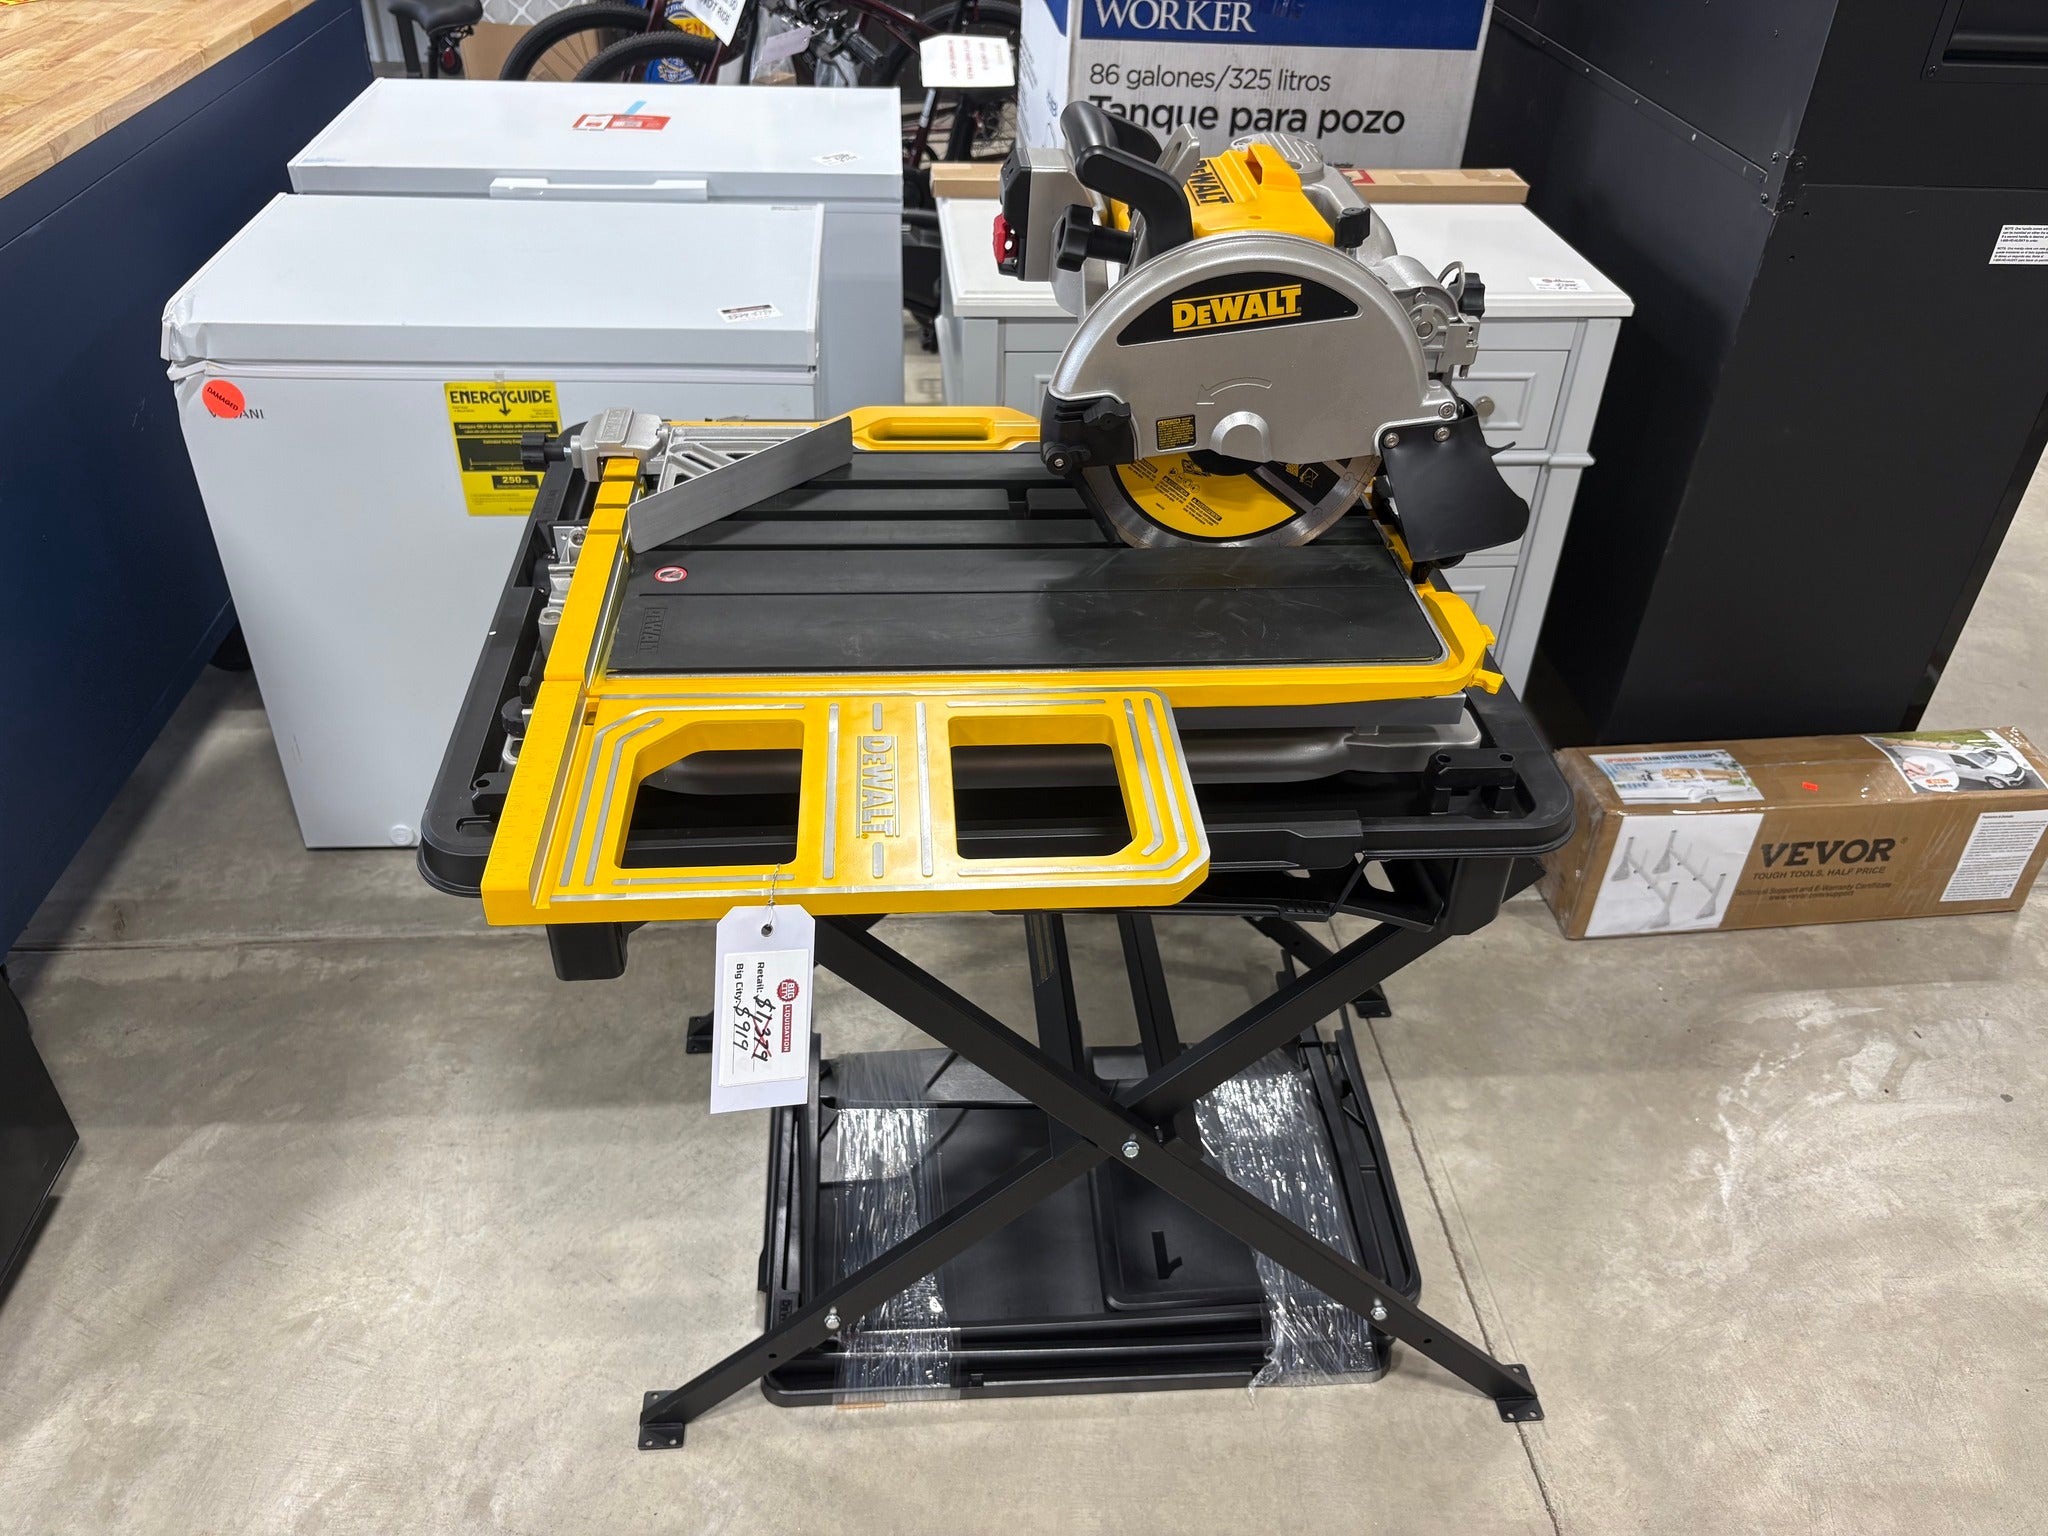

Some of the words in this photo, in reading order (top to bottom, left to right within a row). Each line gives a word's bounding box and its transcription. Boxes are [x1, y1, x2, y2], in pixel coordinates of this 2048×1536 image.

[1093, 0, 1256, 33] WORKER
[1089, 63, 1120, 85] 86
[1126, 65, 1272, 92] galones/325
[1278, 68, 1331, 92] litros
[1229, 106, 1307, 136] para
[1318, 109, 1405, 139] pozo
[207, 386, 239, 411] DAMAGED
[502, 476, 522, 484] 250
[1760, 838, 1896, 868] VEVOR
[1753, 871, 1787, 880] TOUGH
[1827, 868, 1854, 877] HALF
[1855, 866, 1887, 875] PRICE
[734, 963, 744, 980] Big
[756, 961, 765, 993] Retail:
[733, 981, 744, 1004] City:
[733, 1000, 752, 1052] $919
[783, 1004, 791, 1052] LIQUIDATION
